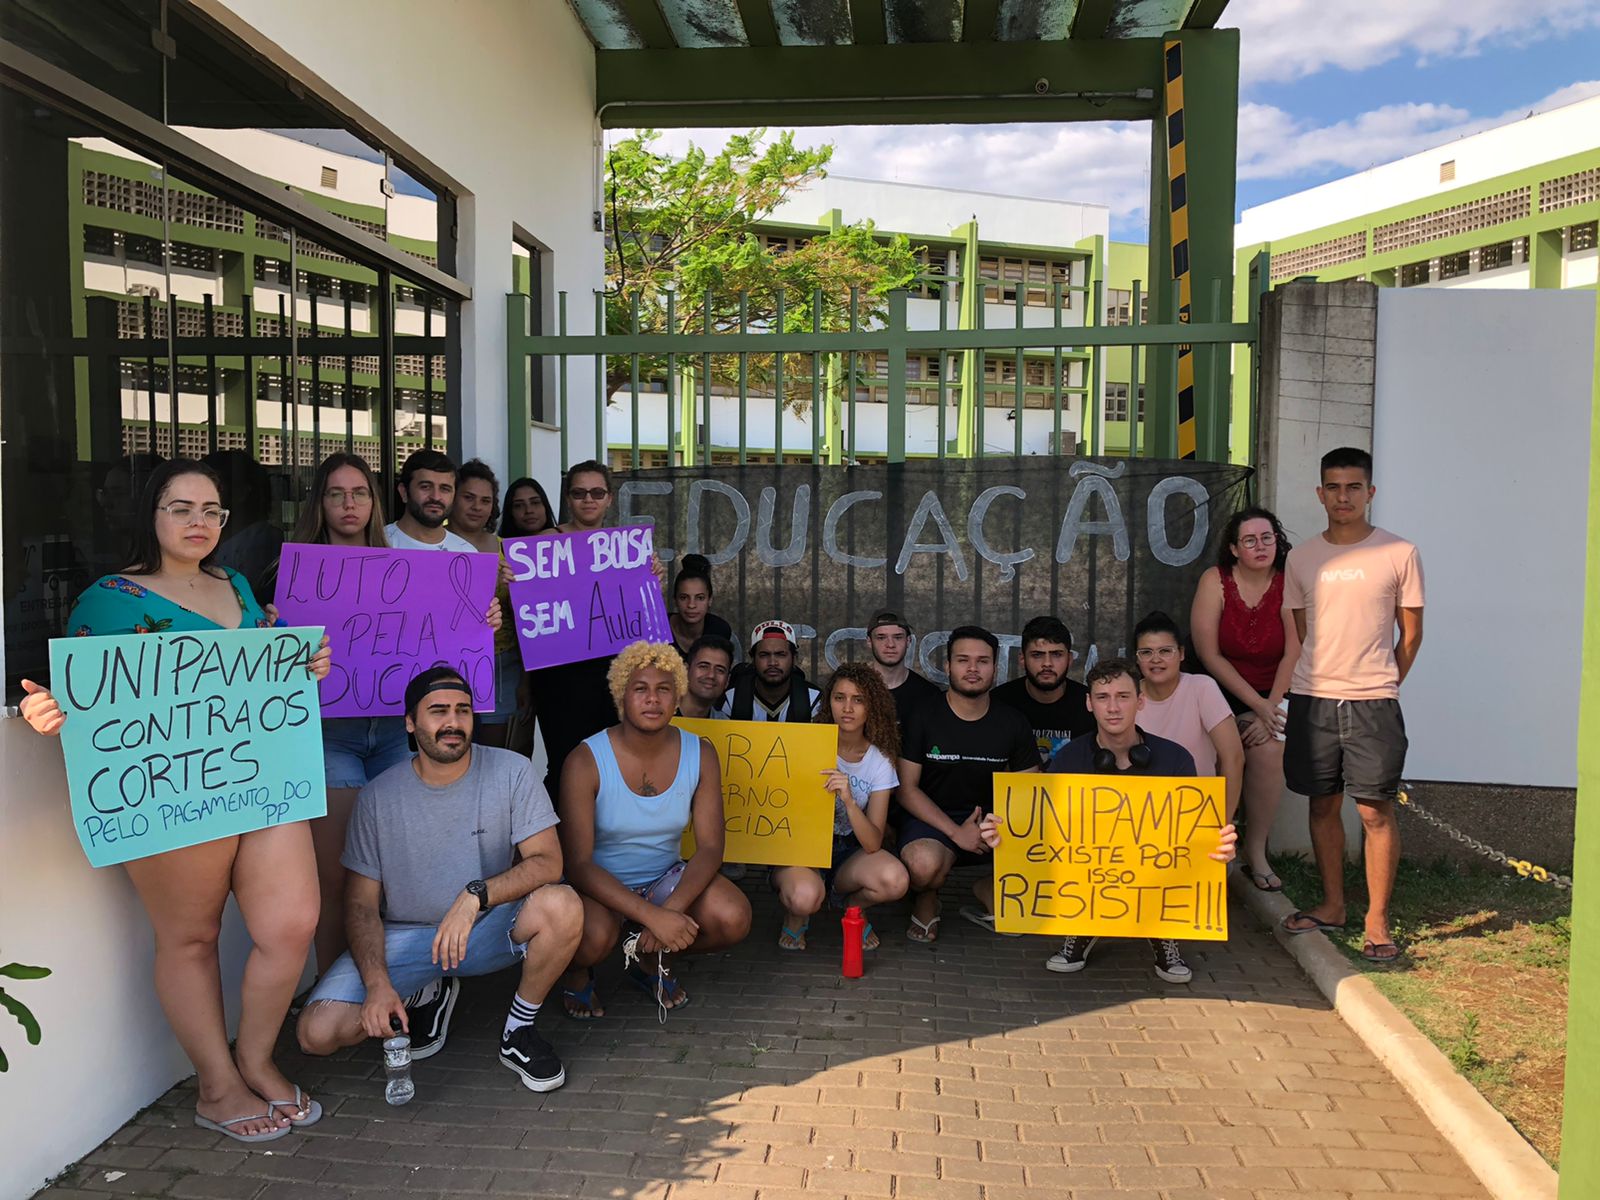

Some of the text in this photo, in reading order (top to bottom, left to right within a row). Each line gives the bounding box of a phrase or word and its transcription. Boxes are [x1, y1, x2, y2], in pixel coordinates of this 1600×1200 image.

[286, 551, 410, 604] LUTO
[508, 528, 653, 582] SEM BOLSA
[1320, 568, 1366, 583] NASA
[342, 611, 438, 657] PELA
[519, 600, 575, 638] SEM
[92, 690, 309, 753] CONTRA OS
[87, 740, 260, 814] CORTES
[926, 752, 960, 761] unipampa
[83, 779, 312, 848] PELO PAGAMENTO DO
[261, 802, 290, 826] PP
[1005, 785, 1224, 848] UNIPAMPA
[1026, 843, 1192, 870] EXISTE POR
[1087, 867, 1136, 885] ISSO
[998, 873, 1224, 933] RESISTE!!!
